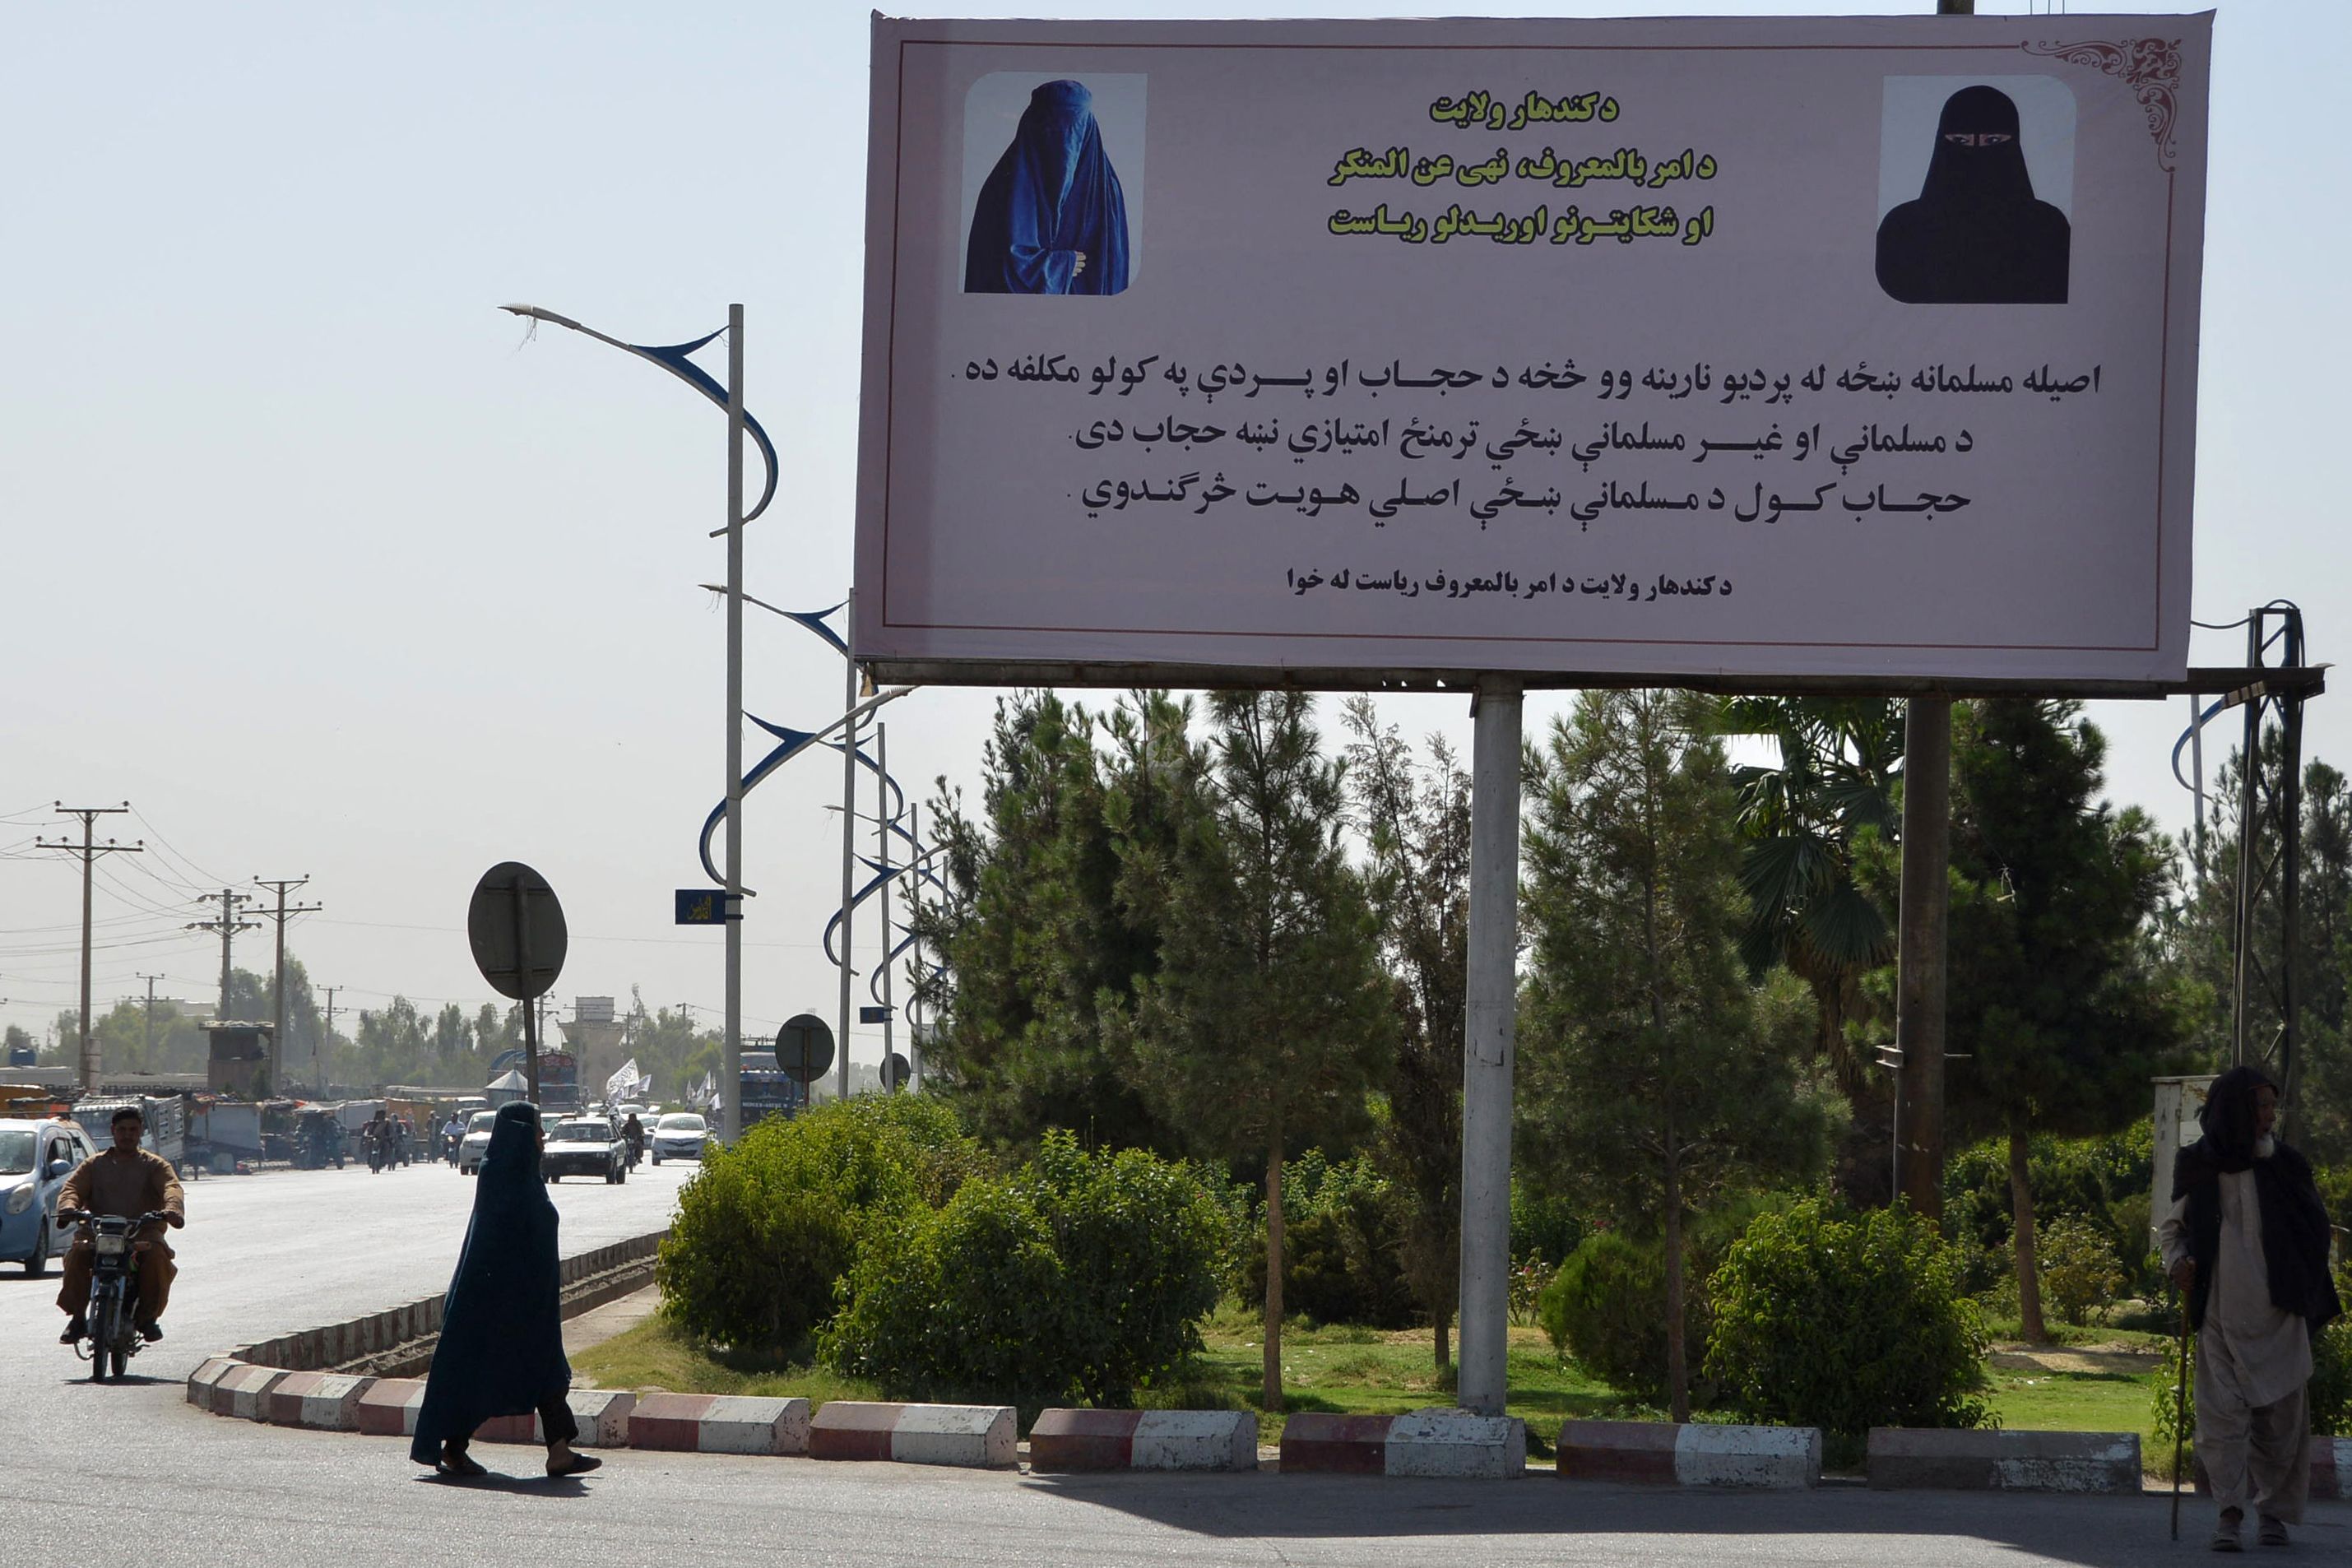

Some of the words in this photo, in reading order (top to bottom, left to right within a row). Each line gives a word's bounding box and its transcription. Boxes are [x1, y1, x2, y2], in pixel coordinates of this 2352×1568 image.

[1428, 89, 1507, 131] ولایت
[1506, 90, 1601, 131] کندهار
[1598, 95, 1621, 123] د
[1326, 146, 1410, 187] المنکر
[1410, 154, 1454, 188] عن
[1455, 146, 1510, 188] نهی
[1646, 147, 1695, 189] امر
[1695, 154, 1718, 180] د
[1327, 202, 1429, 244] ریاست
[1549, 204, 1680, 245] شکایتونو
[1681, 205, 1714, 246] او
[1007, 354, 1080, 383] مکلفه
[1088, 355, 1159, 397] کولو
[1163, 361, 1190, 397] په
[1322, 359, 1349, 397] او
[1358, 360, 1483, 397] حجاب
[1491, 365, 1510, 388] د
[1518, 358, 1587, 389] څخه
[1597, 369, 1632, 400] وو
[1641, 362, 1711, 400] نارینه
[1719, 368, 1793, 405] پردیو
[1800, 364, 1826, 392] له
[1836, 361, 1901, 400] ښځه
[1910, 364, 2013, 393] مسلمانه
[2022, 364, 2101, 402] اصیله
[1133, 415, 1227, 453] حجاب
[1236, 418, 1278, 452] نښه
[1399, 416, 1480, 460] ترمنځ
[1571, 420, 1686, 473] مسلمانې
[1691, 423, 1783, 463] غیر
[1792, 423, 1820, 462] او
[1830, 423, 1946, 476] مسلمانې
[1955, 429, 1974, 452] د
[1246, 482, 1360, 517] هویت
[1469, 476, 1561, 531] ښځې
[1570, 480, 1699, 532] مسلمانې
[1707, 487, 1726, 510] د
[1734, 481, 1837, 524] کول
[1842, 483, 1971, 523] حجاب
[1287, 568, 1324, 596] خوا
[1330, 568, 1350, 590] له
[1355, 569, 1419, 597] ریاست
[1425, 568, 1519, 598] بالمعروف
[1523, 572, 1556, 600] امر
[1561, 577, 1575, 593] د
[1580, 573, 1640, 601] ولایت
[1645, 573, 1716, 602] کندهار
[1719, 579, 1733, 596] د
